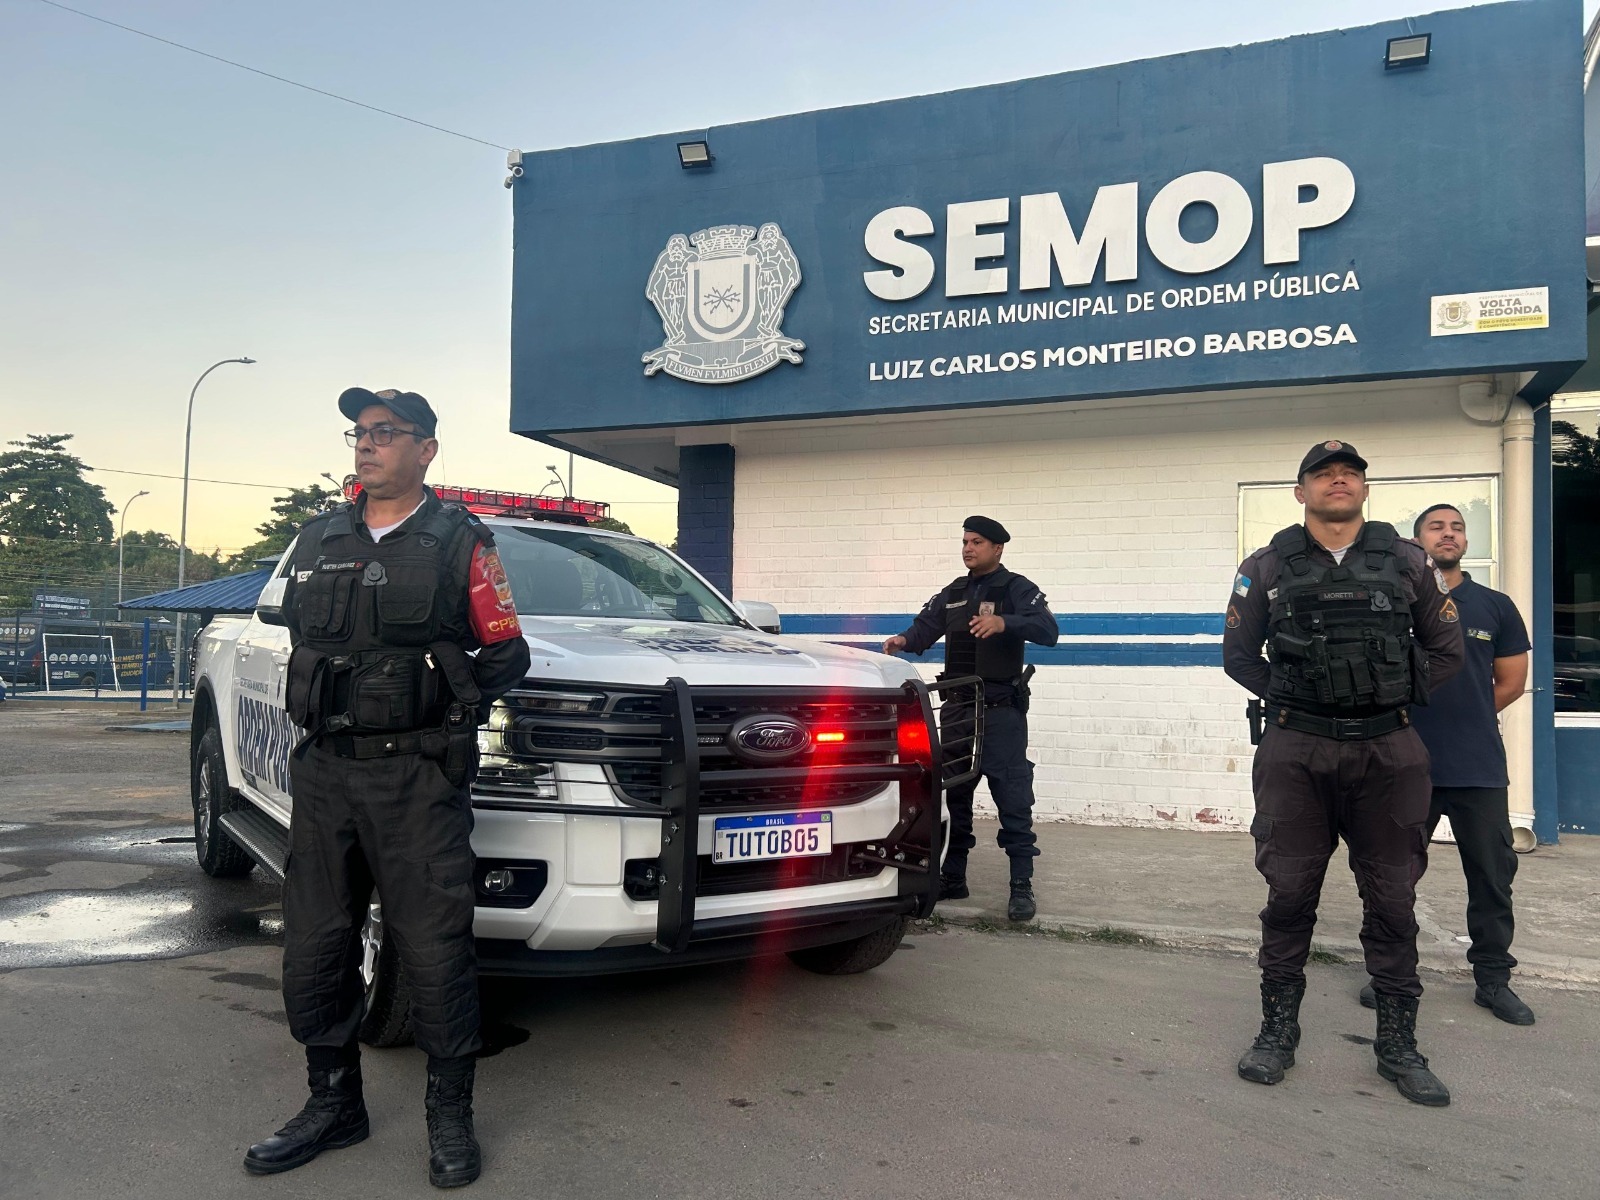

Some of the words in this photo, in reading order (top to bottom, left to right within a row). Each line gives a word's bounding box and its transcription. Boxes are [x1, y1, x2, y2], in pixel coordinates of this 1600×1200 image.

[863, 156, 1356, 300] SEMOP
[869, 308, 991, 335] SECRETARIA
[997, 293, 1118, 323] MUNICIPAL
[1126, 292, 1155, 313] DE
[1161, 282, 1246, 309] ORDEM
[1253, 272, 1360, 300] PÚBLICA
[1480, 298, 1522, 308] VOLTA
[1480, 305, 1542, 317] REDONDA
[869, 359, 924, 381] LUIZ
[929, 350, 1037, 377] CARLOS
[1043, 336, 1197, 368] MONTEIRO
[1204, 323, 1357, 354] BARBOSA
[668, 360, 703, 378] FLVMEN
[705, 368, 742, 379] FVLMINI
[744, 352, 774, 373] FLEXIT
[756, 728, 793, 748] Ford
[765, 818, 785, 826] BRASIL
[715, 852, 723, 860] BR
